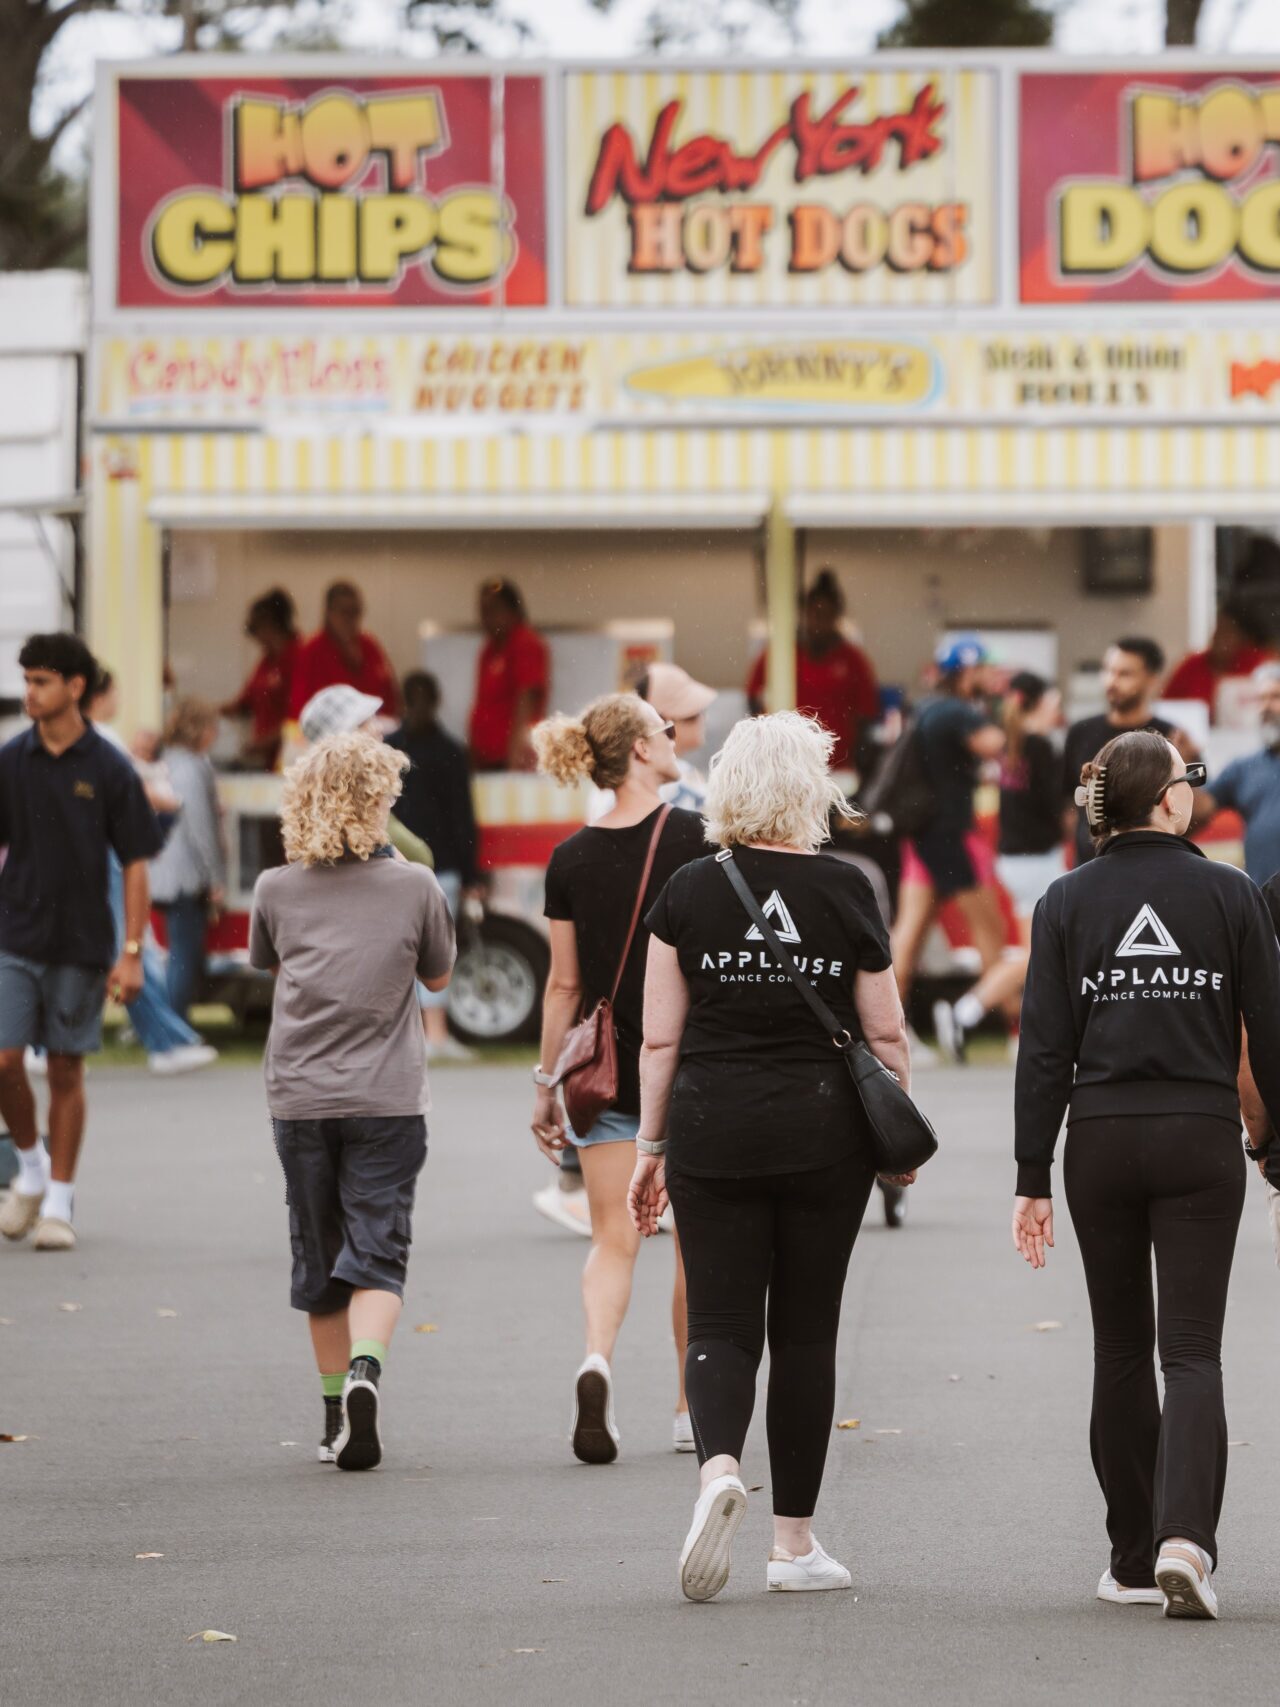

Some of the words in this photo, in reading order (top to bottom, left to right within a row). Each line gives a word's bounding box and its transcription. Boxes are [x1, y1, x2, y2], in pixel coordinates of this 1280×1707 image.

[232, 92, 442, 191] HOT
[584, 98, 790, 217] New
[786, 82, 948, 184] York
[152, 189, 512, 286] CHIPS
[628, 201, 772, 273] HOT
[788, 201, 970, 273] DOGS
[423, 341, 588, 374] CHICKEN
[701, 951, 843, 977] APPLUSE
[720, 974, 762, 983] DANCE
[1093, 991, 1135, 1002] DANCE
